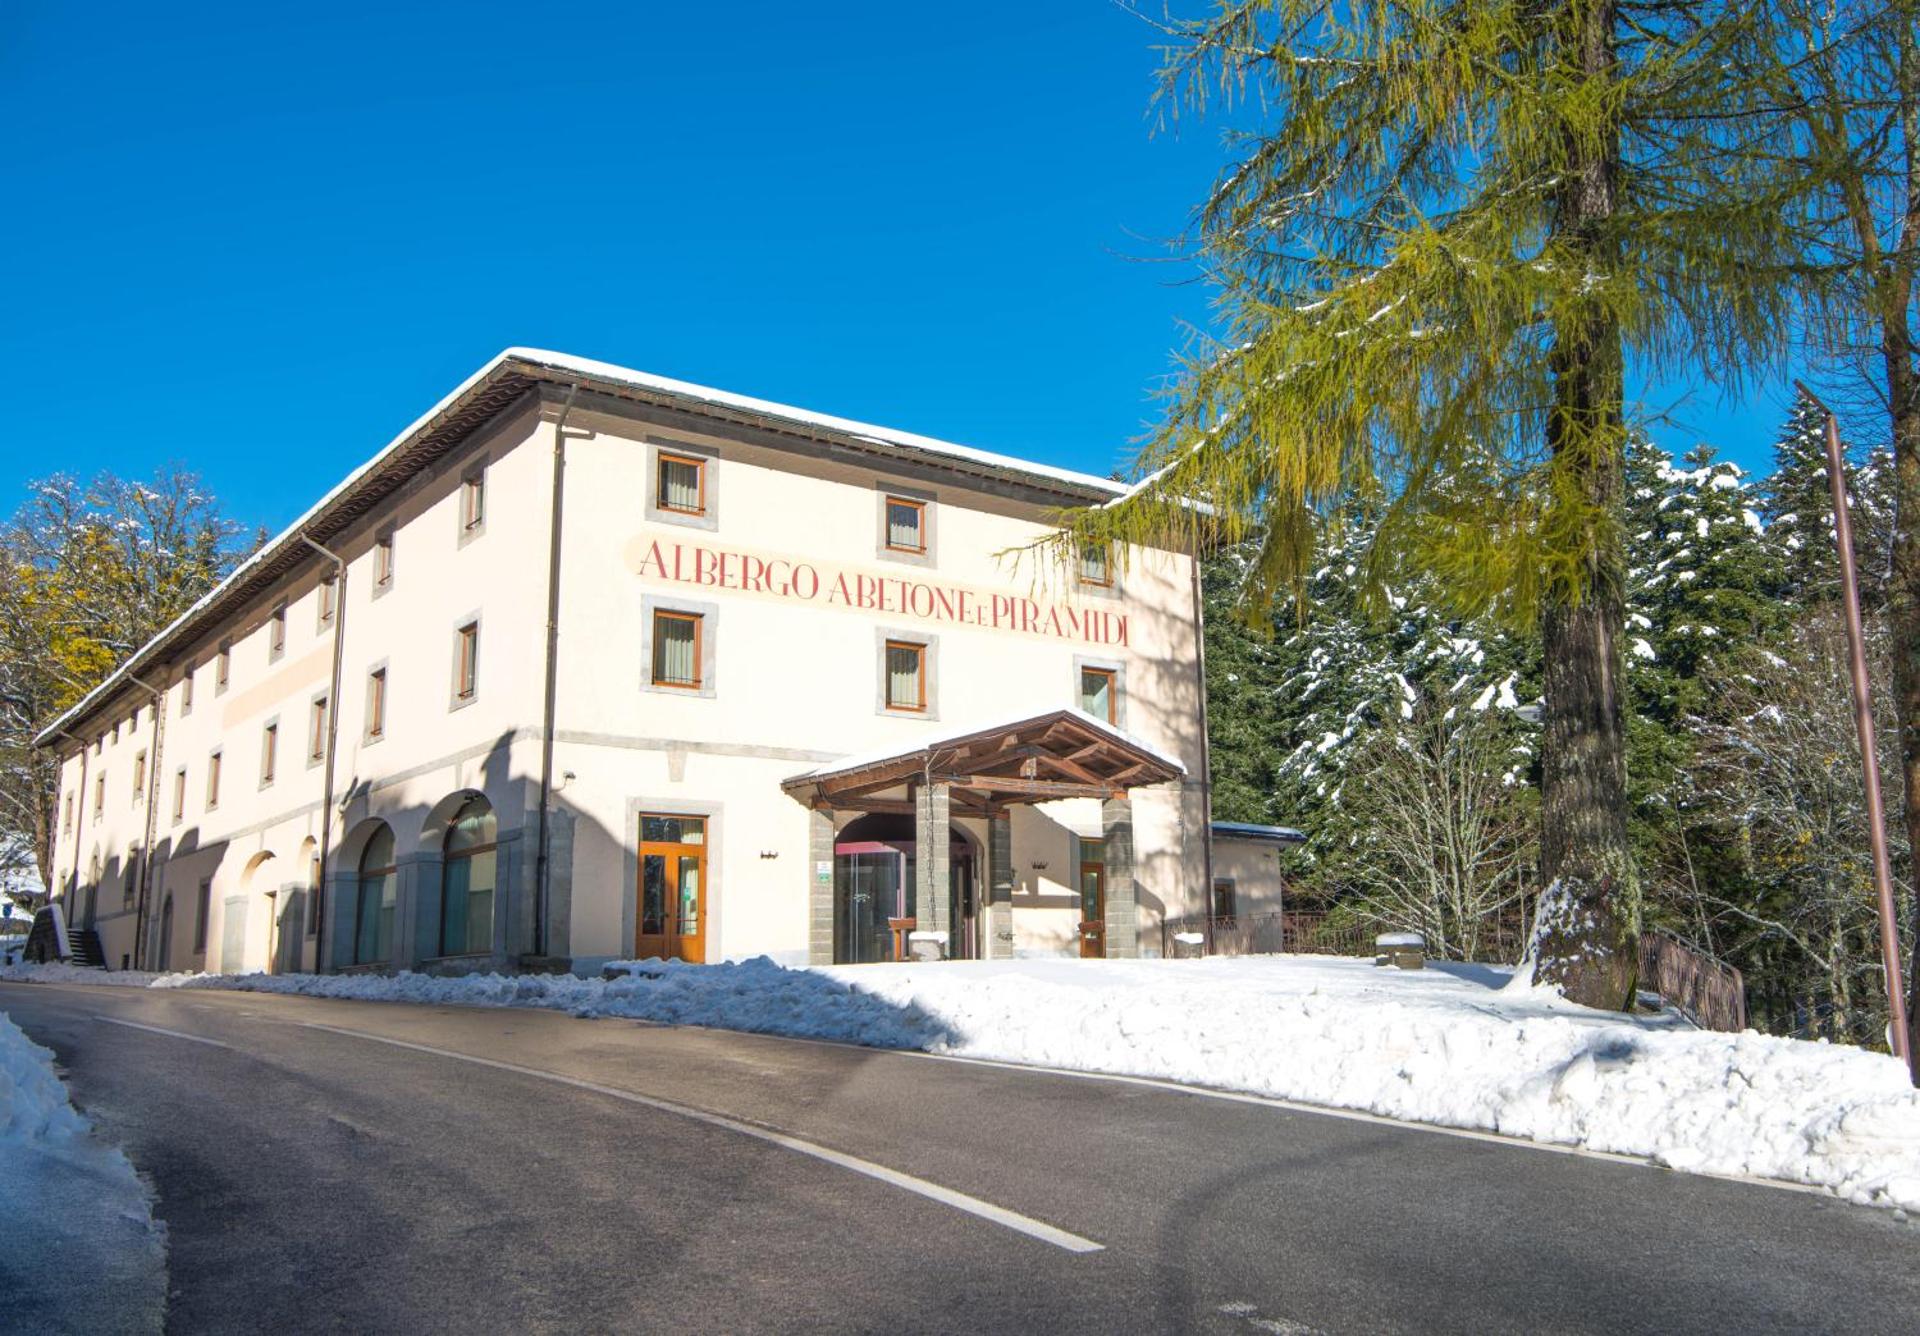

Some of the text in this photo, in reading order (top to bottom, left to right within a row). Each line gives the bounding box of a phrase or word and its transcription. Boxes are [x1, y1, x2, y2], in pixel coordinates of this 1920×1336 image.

[637, 540, 819, 600] ALBERGO
[828, 571, 975, 624] ABETONE
[991, 593, 1129, 647] PIRAMIDI
